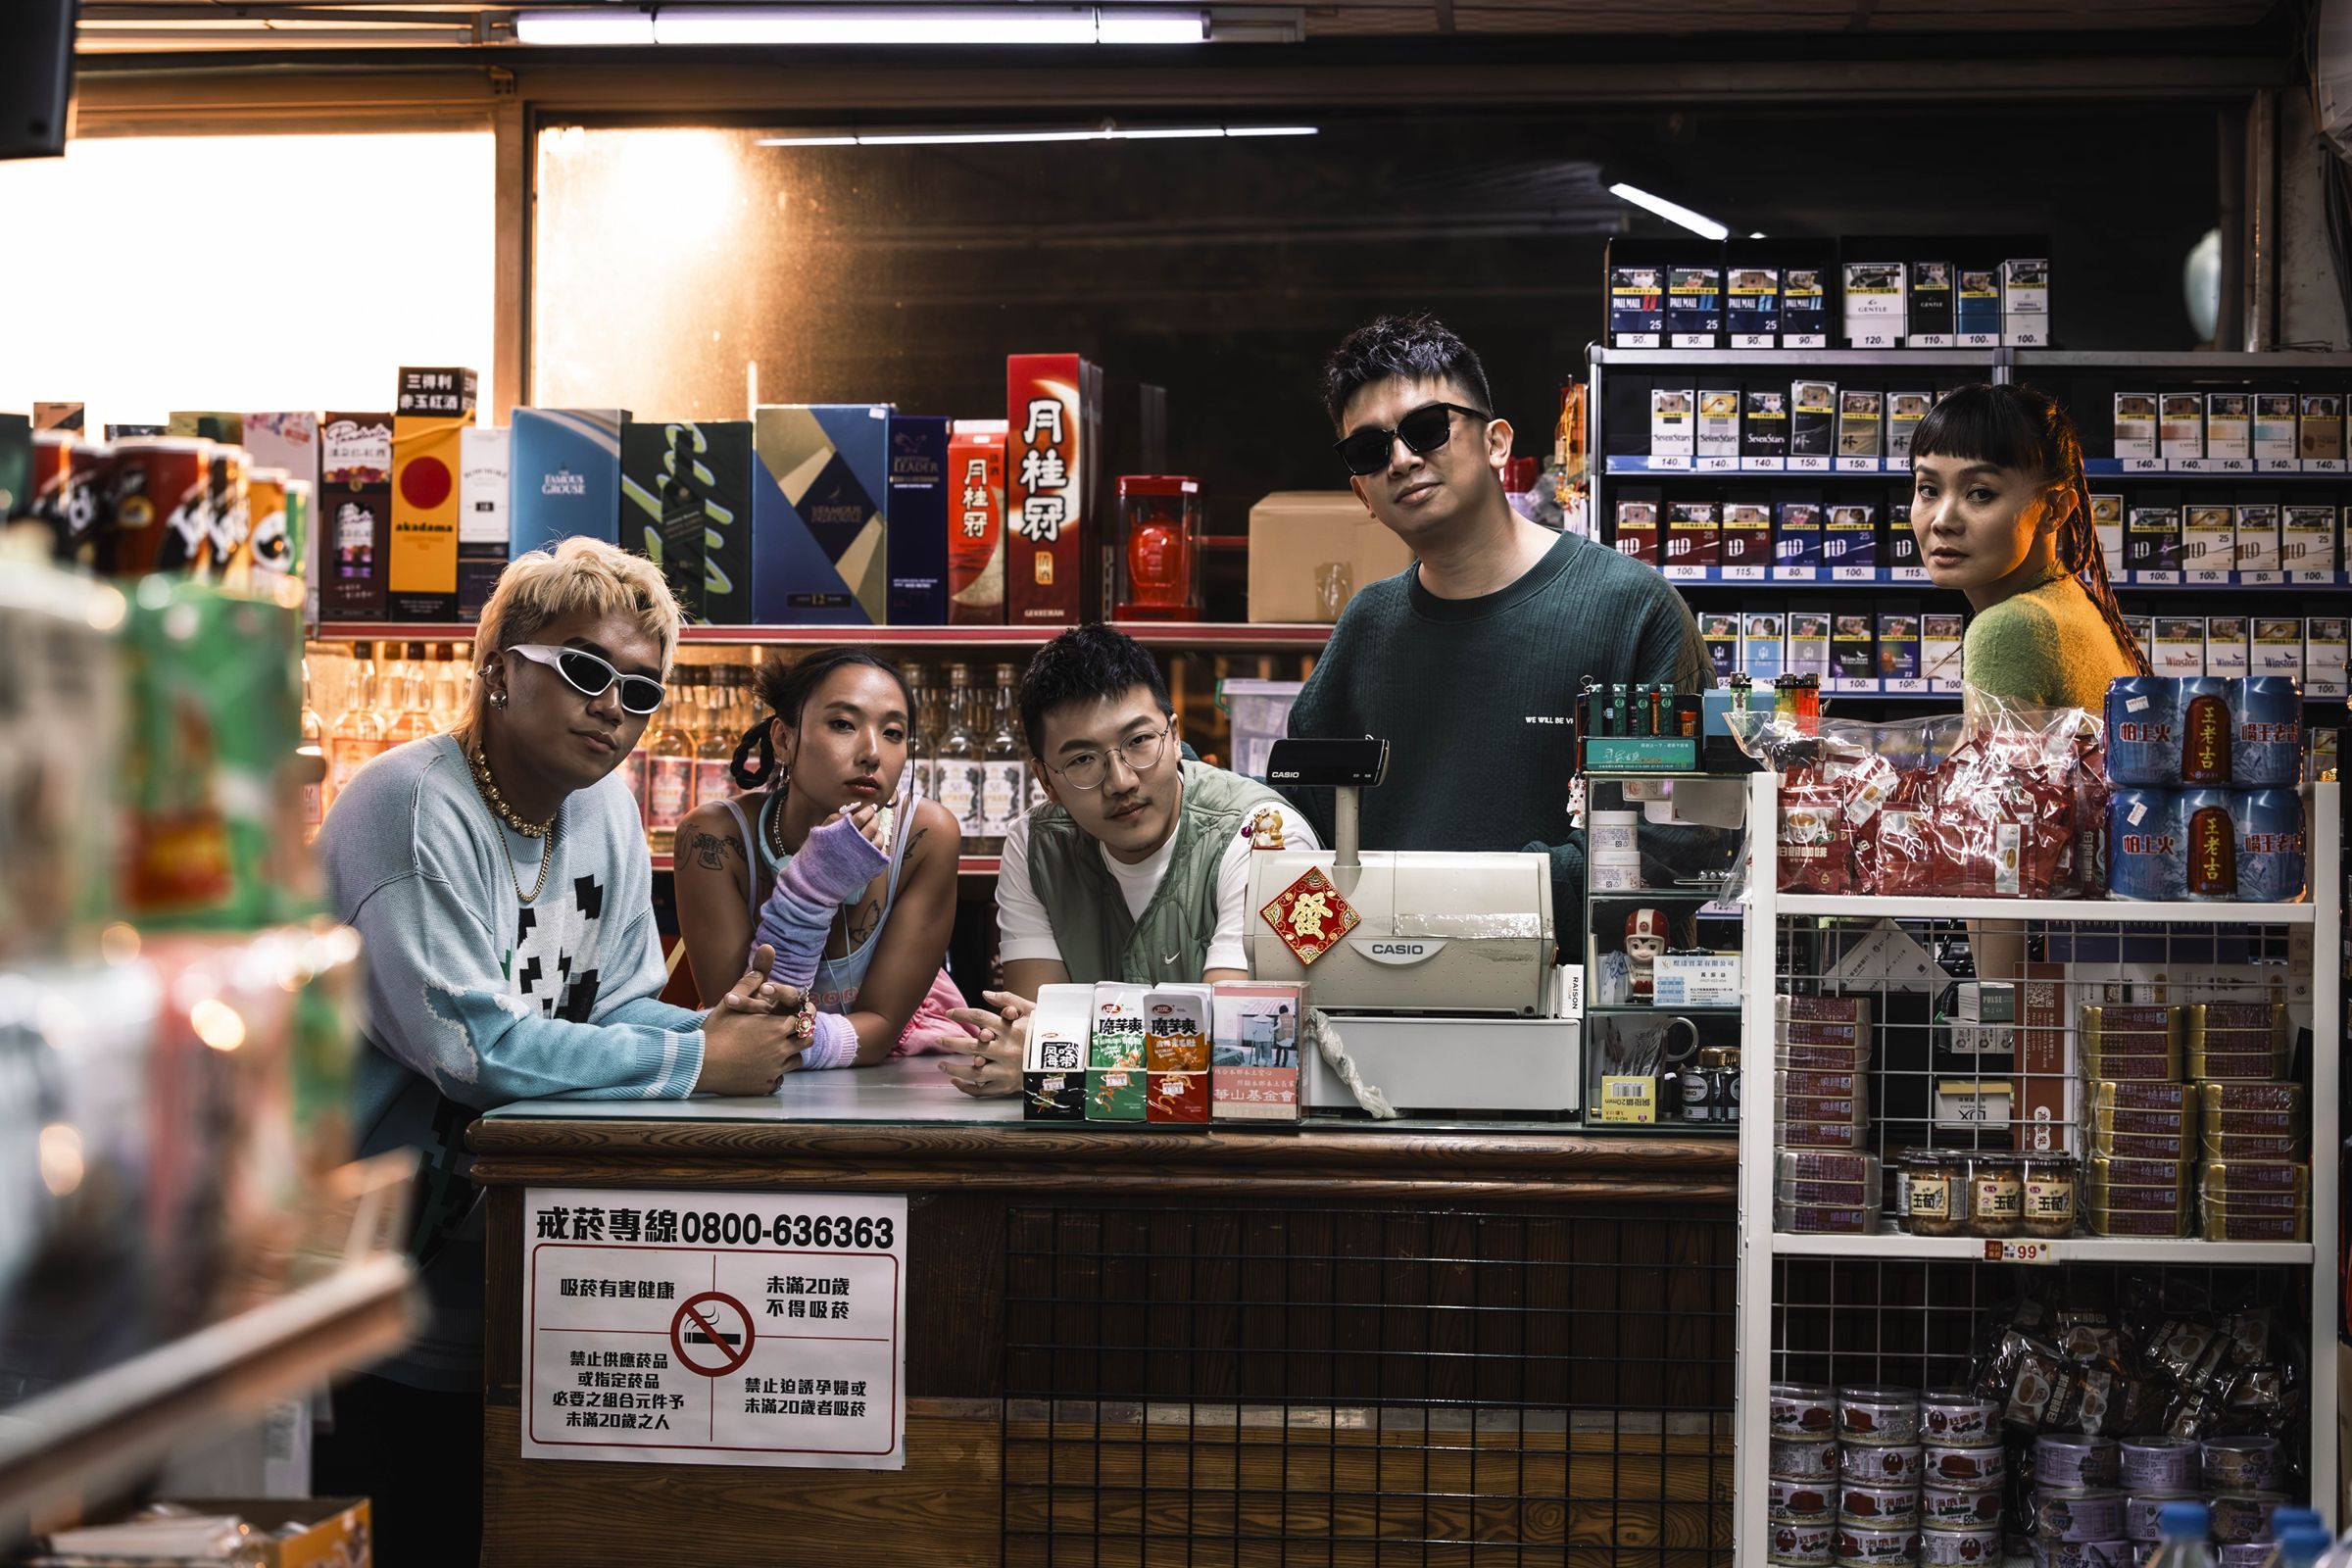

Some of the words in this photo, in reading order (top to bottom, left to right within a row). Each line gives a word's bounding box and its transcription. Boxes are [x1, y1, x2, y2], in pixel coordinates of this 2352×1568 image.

[1613, 298, 1626, 309] PALL
[1627, 298, 1641, 309] MALL
[1670, 298, 1683, 308] PALL
[1683, 298, 1697, 308] MALL
[1729, 298, 1740, 309] PALL
[1741, 298, 1755, 309] MALL
[1786, 299, 1796, 309] PALL
[1797, 299, 1810, 309] MALL
[1650, 320, 1662, 330] 25
[1706, 320, 1718, 330] 25
[1765, 320, 1777, 330] 25
[407, 373, 453, 390] 三得利
[400, 394, 459, 410] 赤玉紅酒
[1654, 433, 1692, 443] SevenStars
[1700, 434, 1737, 444] SevenStars
[1747, 433, 1785, 444] SevenStars
[1019, 399, 1068, 543] 月桂冠
[544, 474, 584, 485] FAMOUS
[541, 484, 586, 495] GROUSE
[961, 458, 990, 538] 月桂冠
[395, 521, 453, 534] akadama
[2219, 534, 2230, 543] 25
[2319, 535, 2328, 544] 25
[2165, 656, 2199, 667] Winston
[2216, 658, 2245, 667] Winston
[2265, 657, 2298, 668] Winston
[2120, 722, 2172, 743] 怕上火
[2199, 707, 2217, 769] 王老吉
[2123, 834, 2175, 855] 怕上火
[2203, 817, 2221, 881] 王老吉
[1372, 944, 1424, 956] CASIO
[1152, 1017, 1198, 1036] 魔芋爽
[1213, 1089, 1296, 1102] 華山基金會
[536, 1206, 894, 1249] 戒菸專線0800-636363
[2017, 1245, 2037, 1259] 99
[560, 1277, 675, 1299] 吸菸有害健康
[766, 1276, 850, 1297] 未滿20歲
[766, 1298, 850, 1320] 不得吸菸
[569, 1350, 668, 1369] 禁止供應菸品
[577, 1371, 660, 1390] 或指定菸品
[745, 1377, 867, 1397] 禁止迫誘孕婦或
[553, 1391, 685, 1410] 必要之組合元件予
[744, 1397, 866, 1418] 未滿20歲者吸菸
[565, 1412, 670, 1431] 未滿20歲之人
